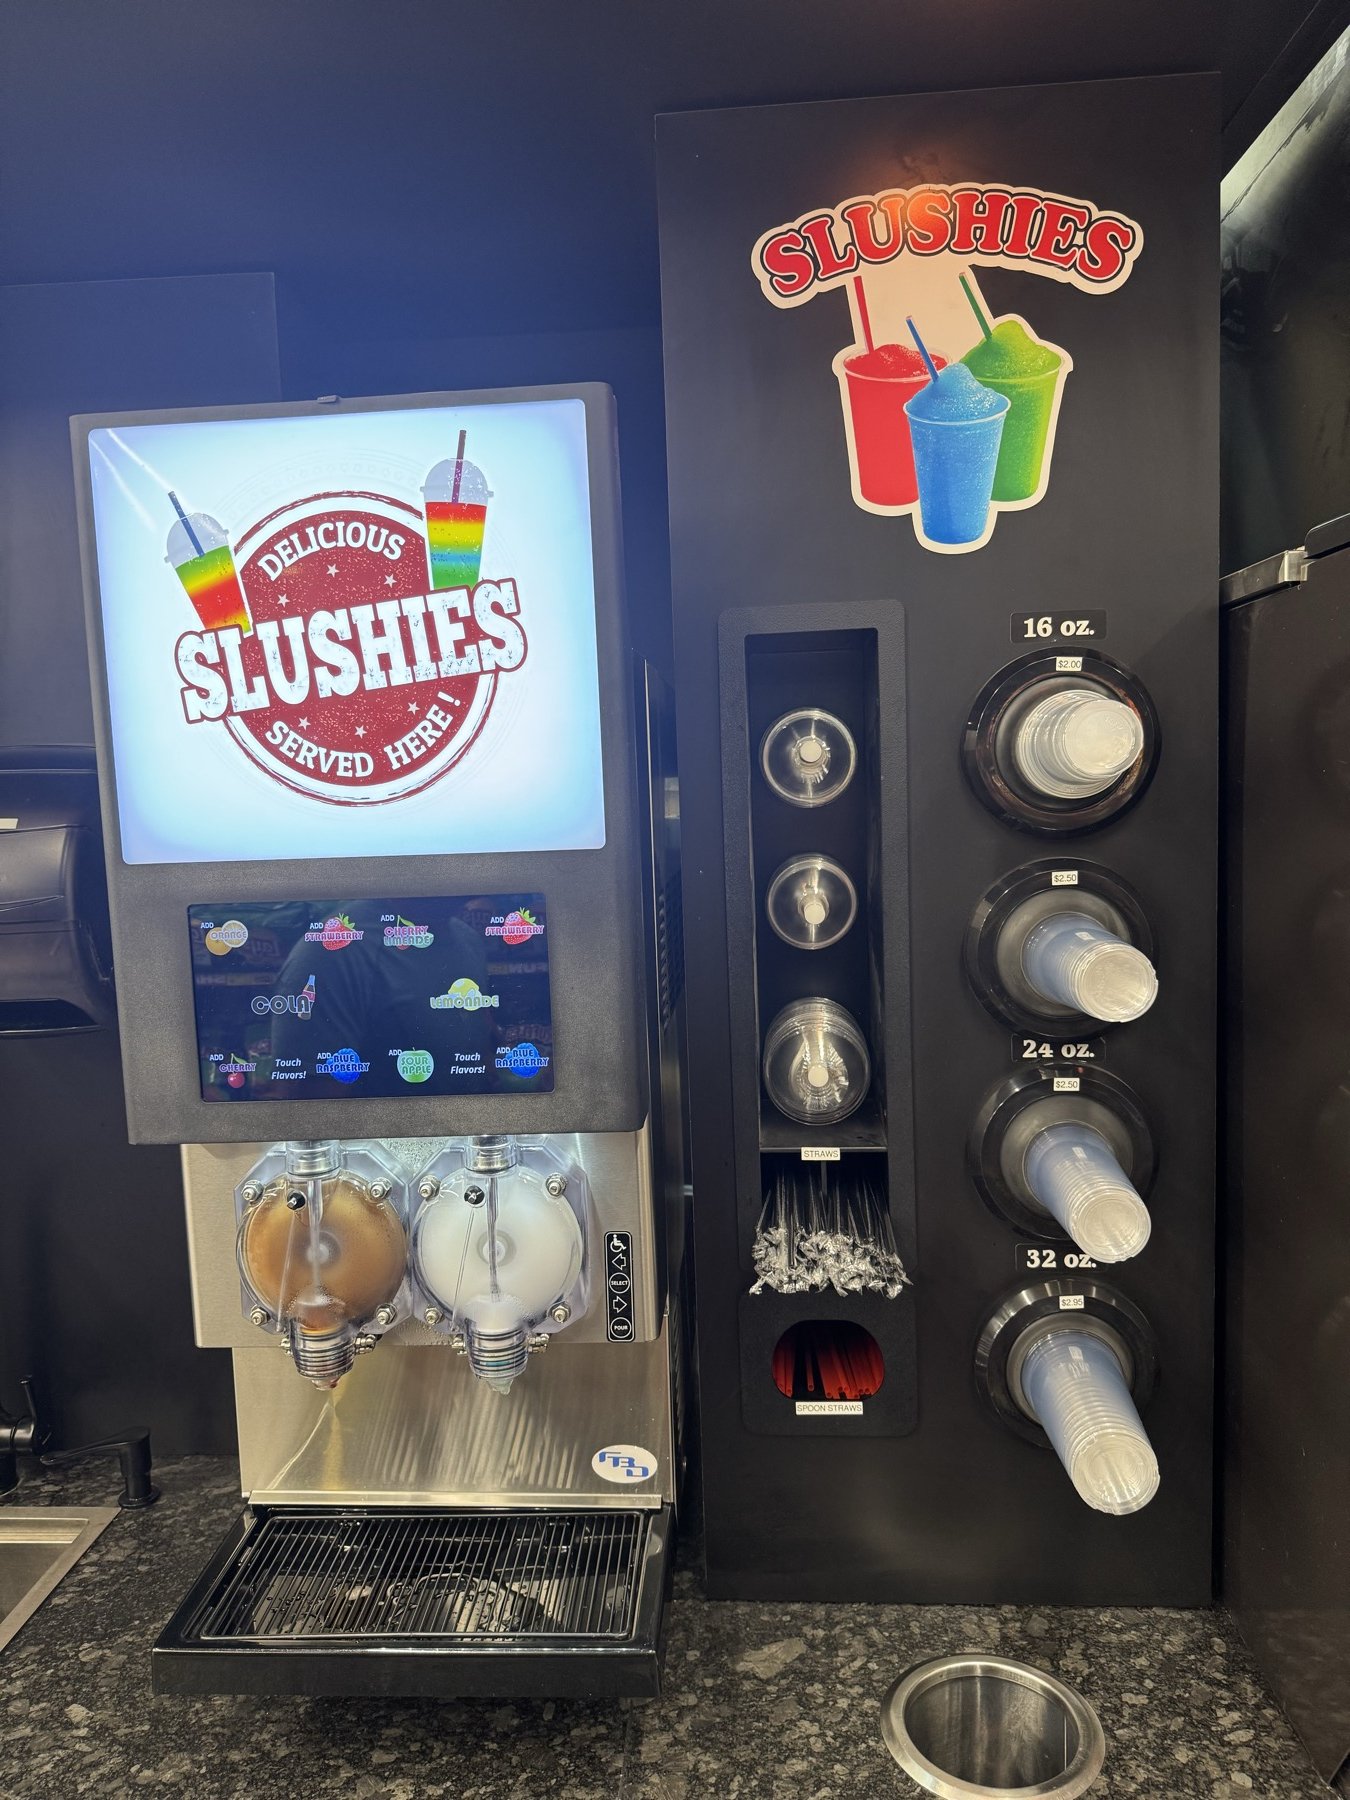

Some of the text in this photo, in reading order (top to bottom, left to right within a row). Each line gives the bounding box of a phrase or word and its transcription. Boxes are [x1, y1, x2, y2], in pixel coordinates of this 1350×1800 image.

[763, 188, 1134, 295] SLUSHIES
[257, 522, 406, 581] DELICIOUS
[1023, 616, 1095, 638] 16 oz.
[175, 579, 527, 723] SLUSHIES
[1057, 659, 1082, 669] $2.00
[265, 721, 374, 777] SERVED
[1053, 873, 1077, 883] $2.50
[380, 914, 395, 922] ADD
[490, 916, 504, 924] ADD
[200, 921, 214, 929] ADD
[309, 922, 324, 930] ADD
[210, 930, 248, 940] ORANGE
[384, 926, 429, 936] CHERRY
[485, 925, 544, 936] STRAWBERRY
[304, 931, 364, 942] STRAWBERRY
[251, 995, 311, 1015] COLA
[429, 995, 499, 1009] LEMONADE
[512, 1049, 534, 1058] BLUE
[1022, 1039, 1095, 1058] 24 oz.
[209, 1053, 224, 1061] ADD
[317, 1052, 332, 1060] ADD
[333, 1054, 355, 1063] BLUE
[400, 1056, 429, 1066] SOUR
[454, 1053, 481, 1061] Touch
[275, 1058, 302, 1067] Touch
[495, 1057, 549, 1068] RASPBERRY
[219, 1063, 256, 1073] CHERRY
[316, 1063, 370, 1073] RASPBERRY
[401, 1065, 431, 1075] APPLE
[450, 1065, 485, 1074] Flavors!
[271, 1071, 307, 1080] Flavors!
[1055, 1080, 1078, 1089] $2.50
[803, 1150, 839, 1158] STRAWS
[1026, 1249, 1097, 1268] 32 oz.
[1061, 1298, 1083, 1307] $2.95
[797, 1404, 862, 1412] SPOON STRAWS
